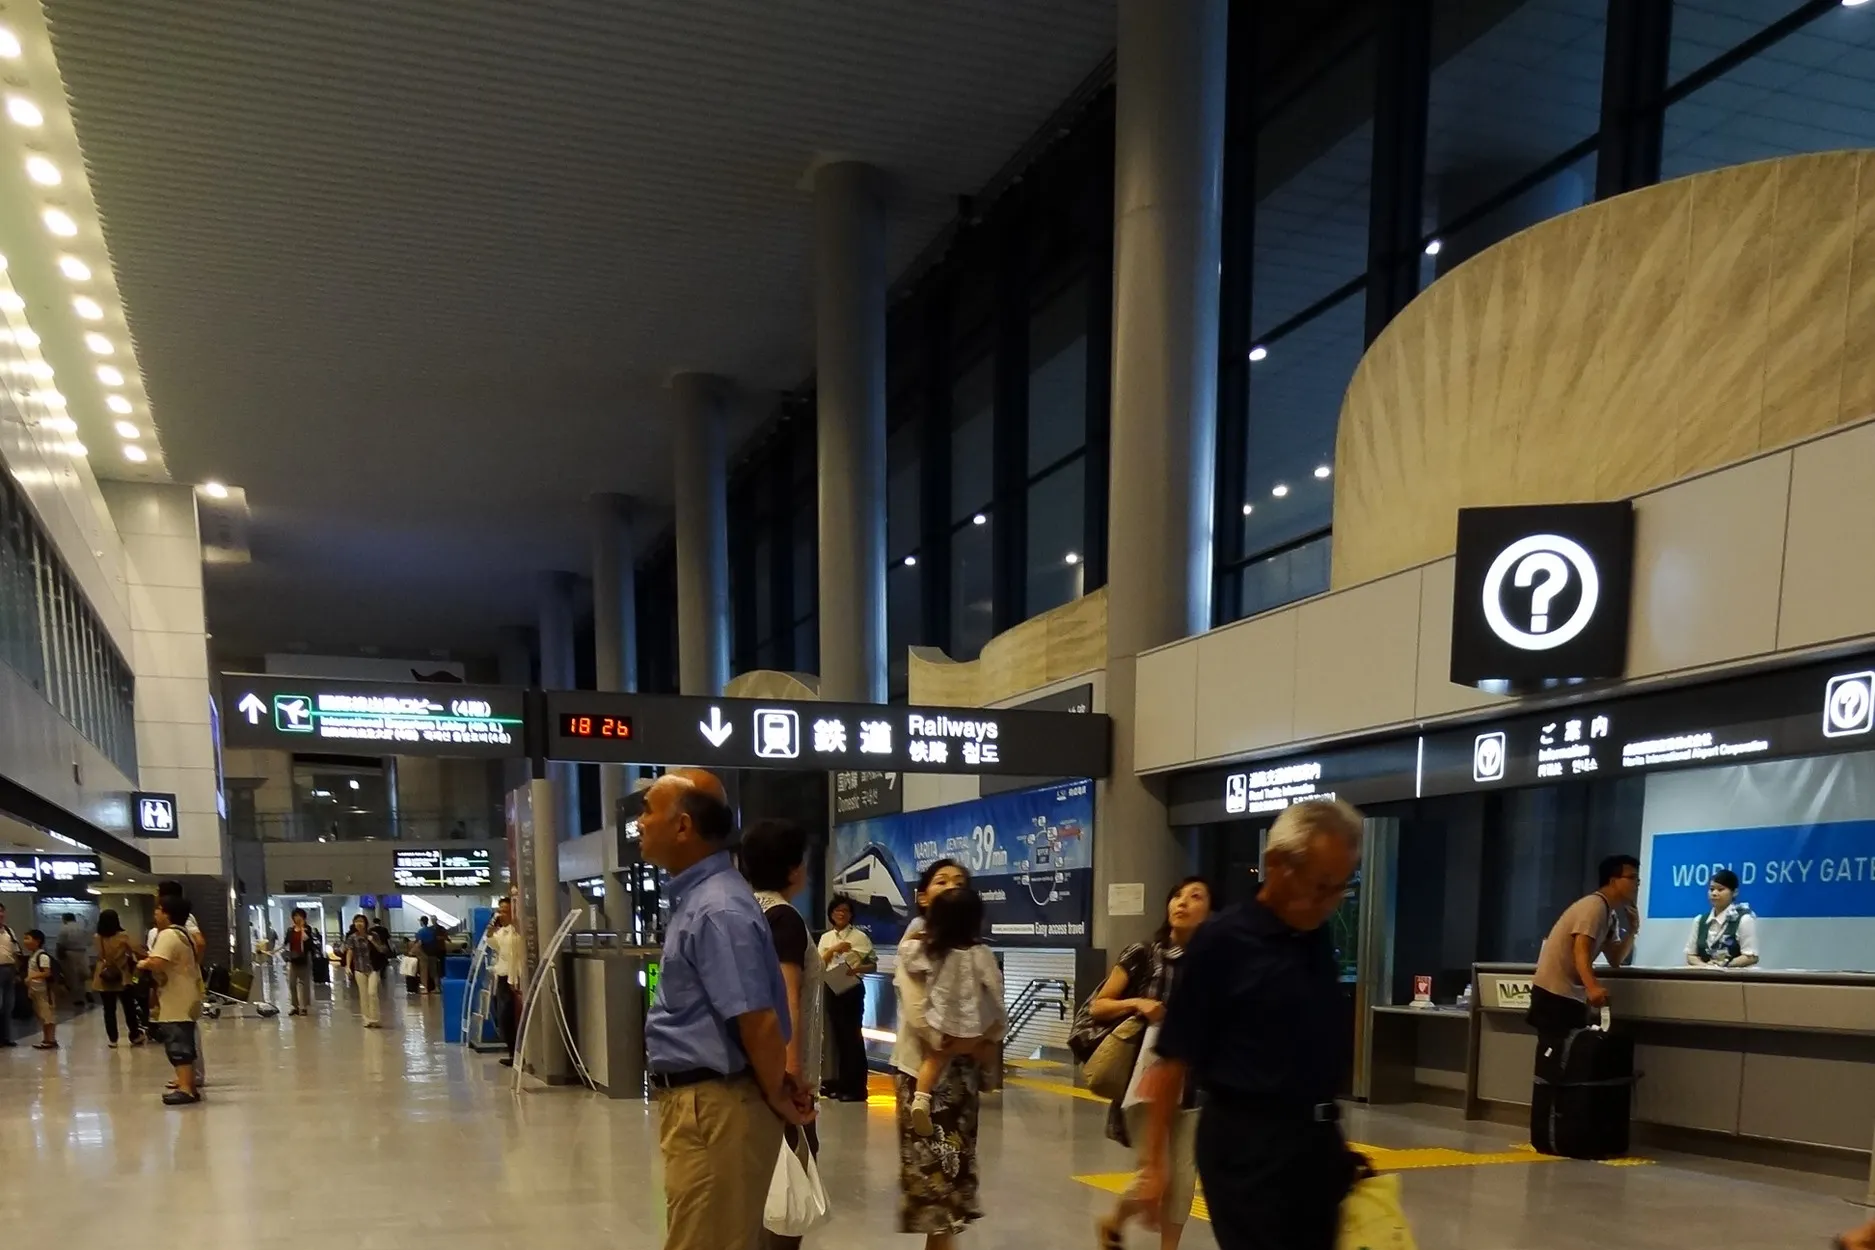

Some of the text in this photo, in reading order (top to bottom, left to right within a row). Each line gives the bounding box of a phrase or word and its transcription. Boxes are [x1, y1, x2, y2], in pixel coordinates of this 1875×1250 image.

[908, 714, 998, 743] Railways
[972, 824, 995, 871] 39
[1765, 859, 1813, 884] SKY
[1035, 921, 1048, 937] Easy
[1048, 924, 1067, 935] access
[1067, 921, 1085, 935] travel
